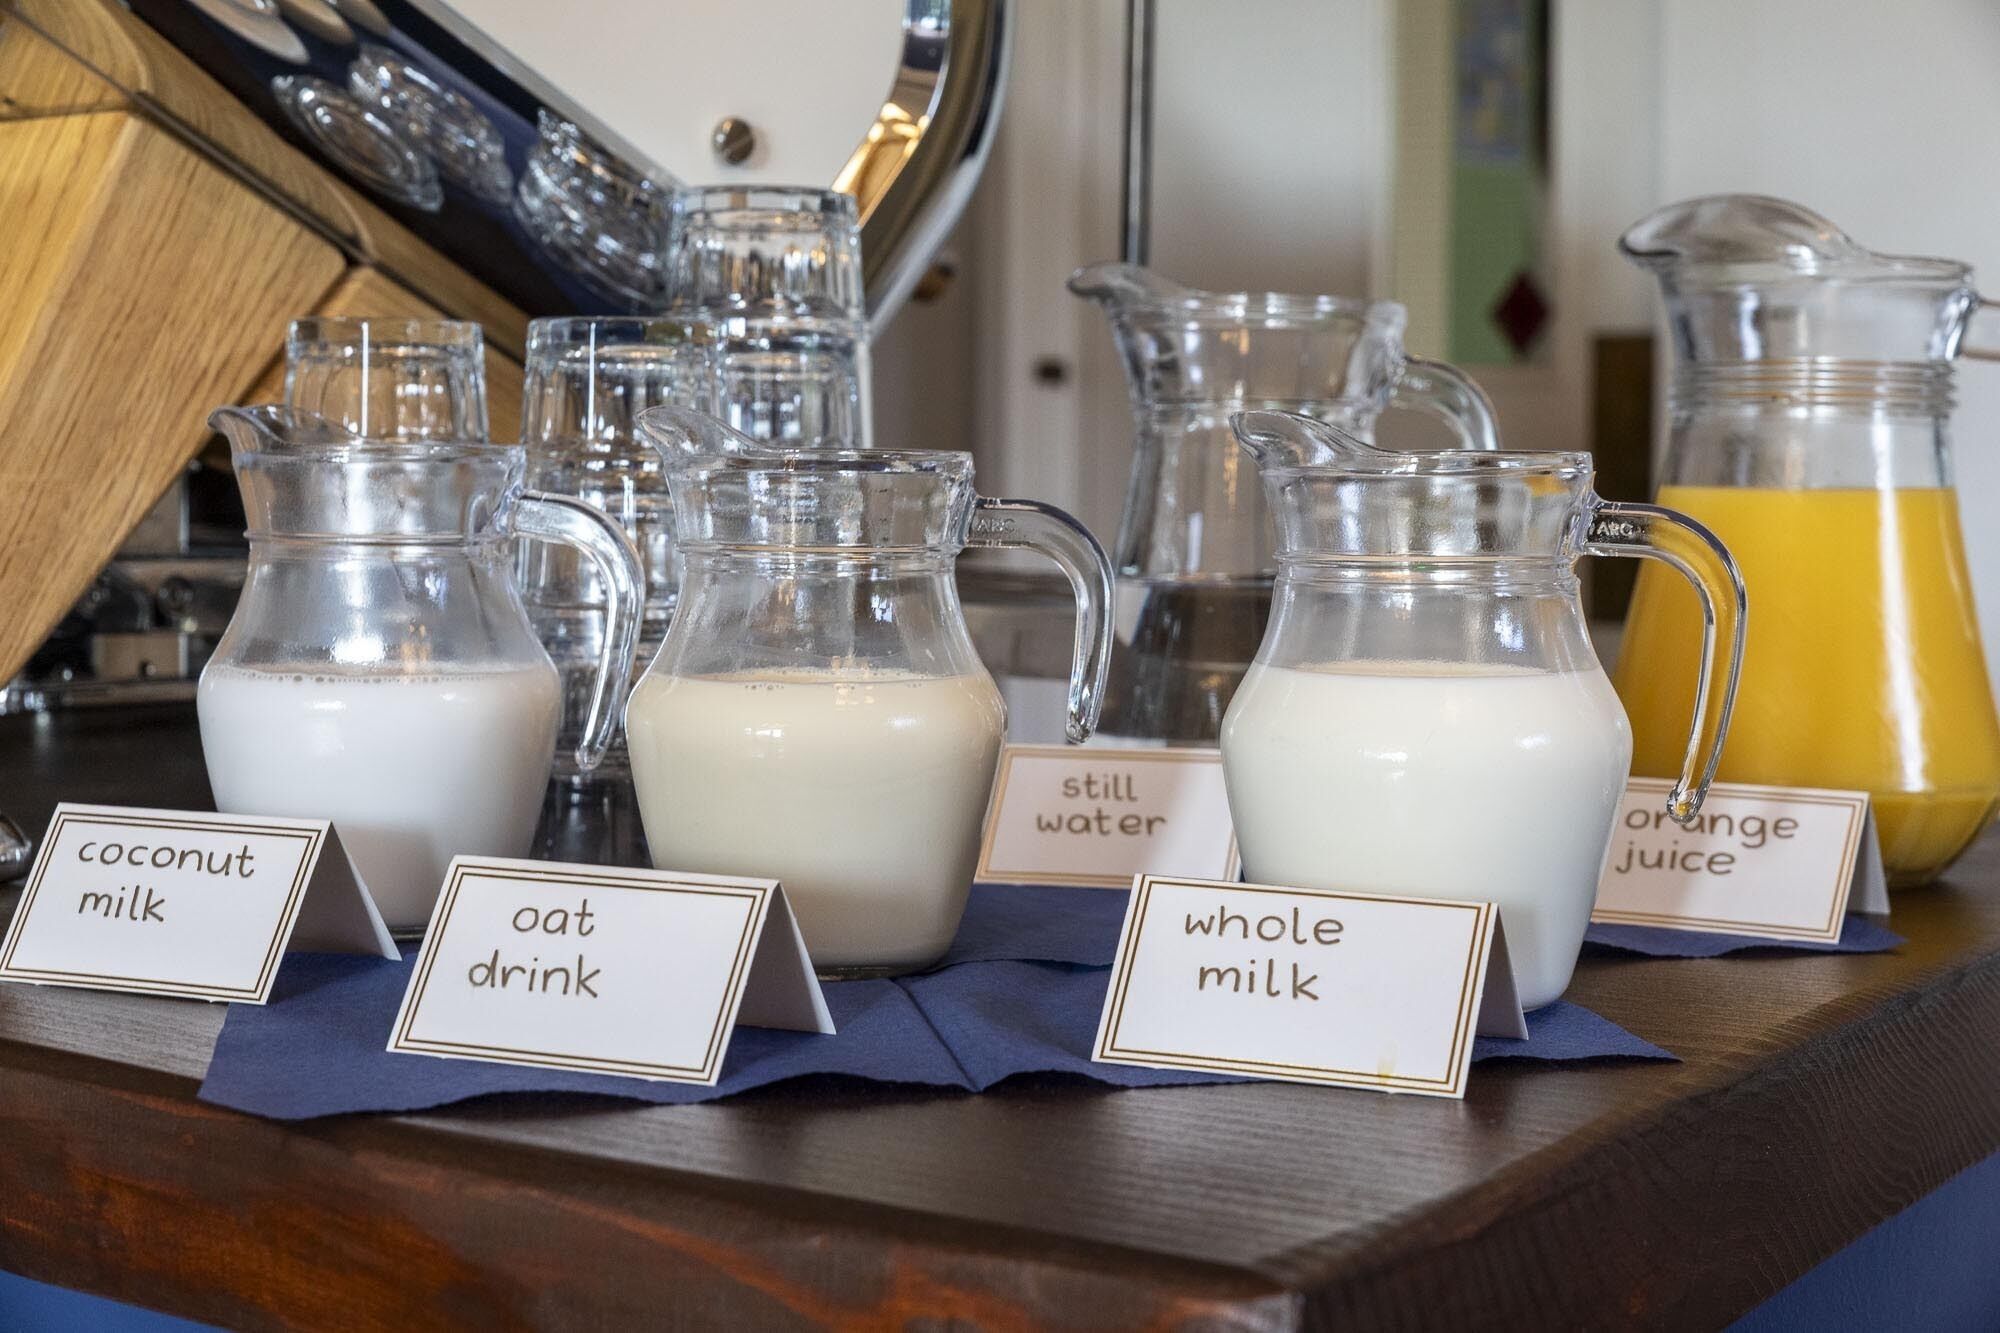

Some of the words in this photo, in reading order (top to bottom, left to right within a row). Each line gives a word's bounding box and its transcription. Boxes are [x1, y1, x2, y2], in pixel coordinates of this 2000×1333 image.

[1062, 772, 1138, 802] still
[1036, 806, 1167, 836] water
[78, 841, 255, 879] coconut
[1615, 841, 1736, 876] juice
[78, 885, 165, 923] milk
[512, 898, 595, 937] oat
[1184, 905, 1344, 946] whole
[468, 949, 601, 999] drink
[1199, 958, 1319, 1001] milk
